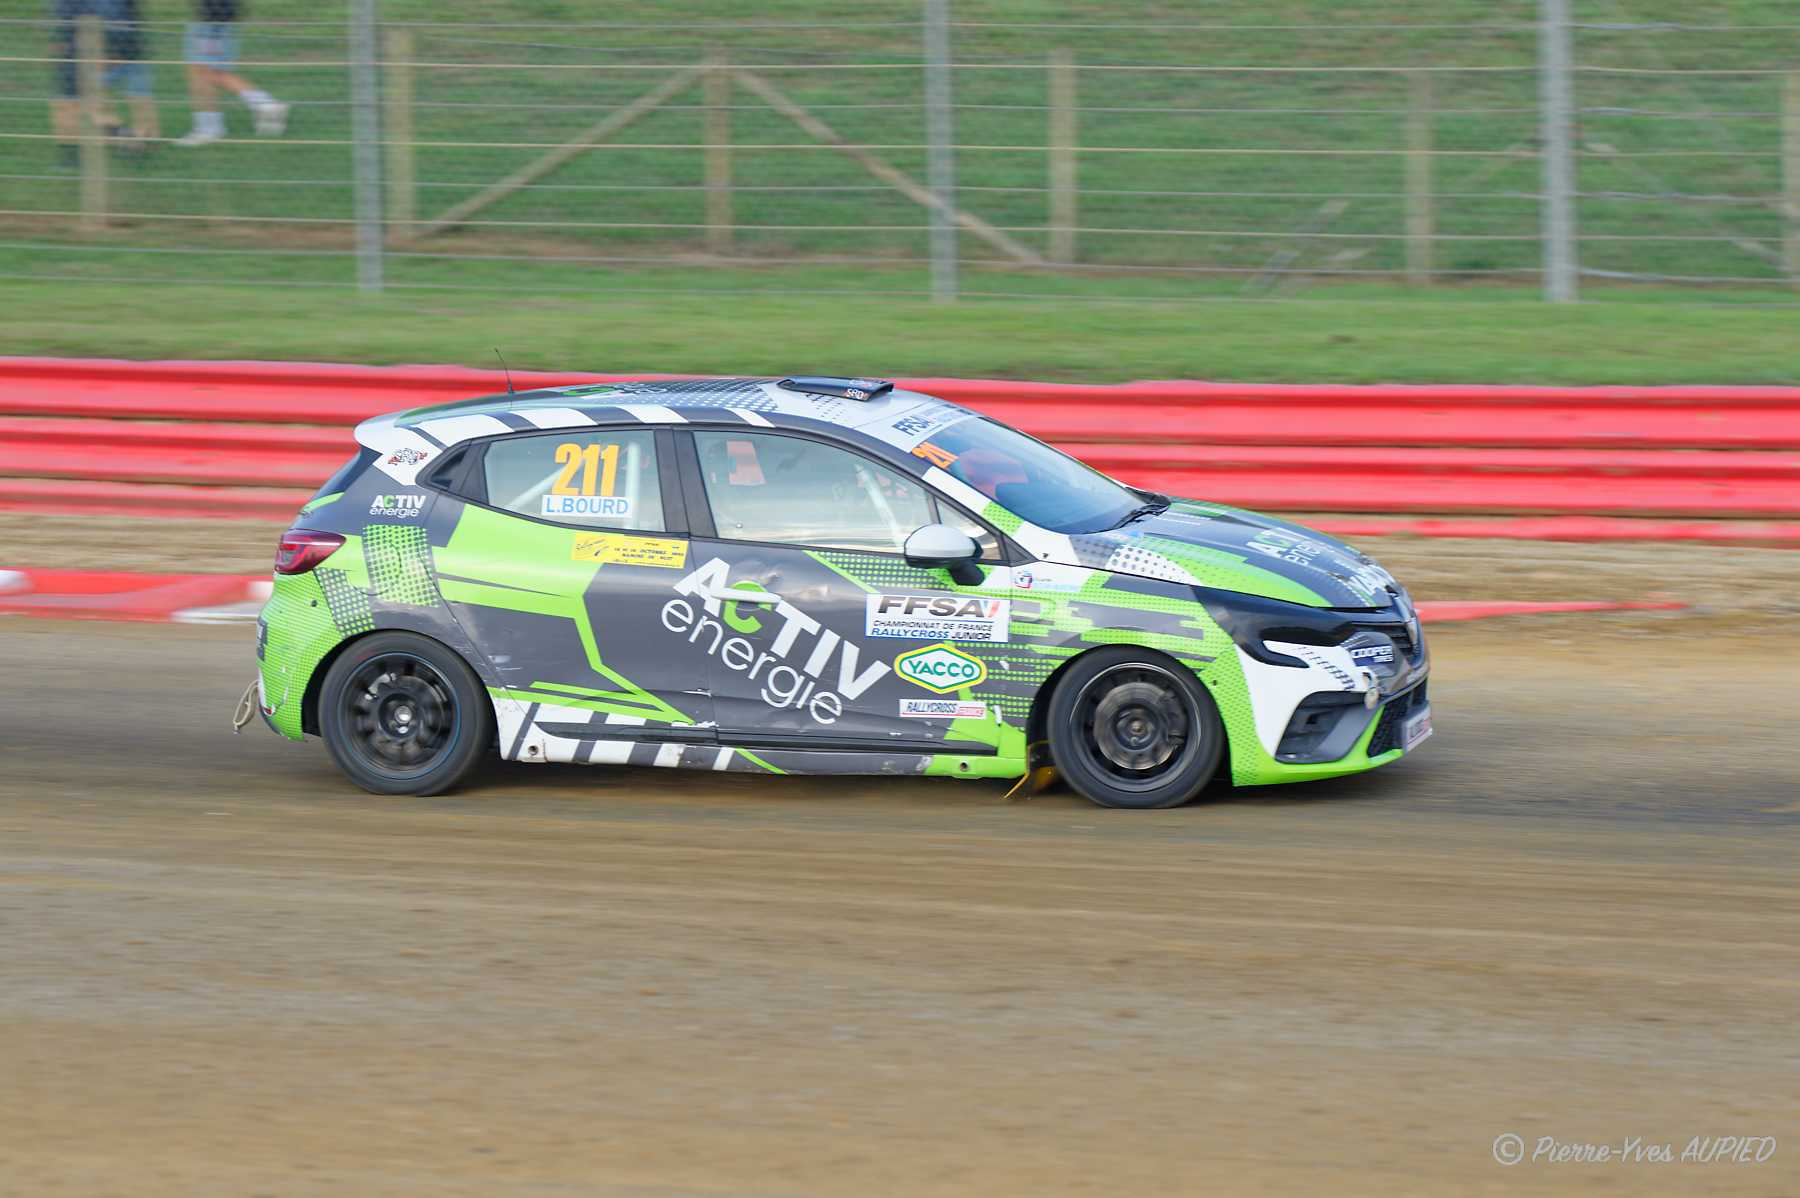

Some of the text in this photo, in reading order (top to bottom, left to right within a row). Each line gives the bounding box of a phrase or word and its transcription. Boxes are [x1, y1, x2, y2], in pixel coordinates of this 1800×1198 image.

[552, 443, 620, 497] 211
[371, 494, 426, 509] ACTIV
[546, 497, 629, 514] L.BOURD
[370, 507, 420, 519] energie
[878, 595, 985, 618] FFSA
[673, 557, 892, 701] ACTIV
[872, 627, 992, 640] RALLYCROSS JUNIOR
[873, 619, 940, 630] CHAMPIONNAT
[958, 623, 993, 632] FRANCE
[661, 599, 843, 725] energie
[908, 660, 975, 678] YACCO
[907, 702, 957, 713] RALLYCROSS
